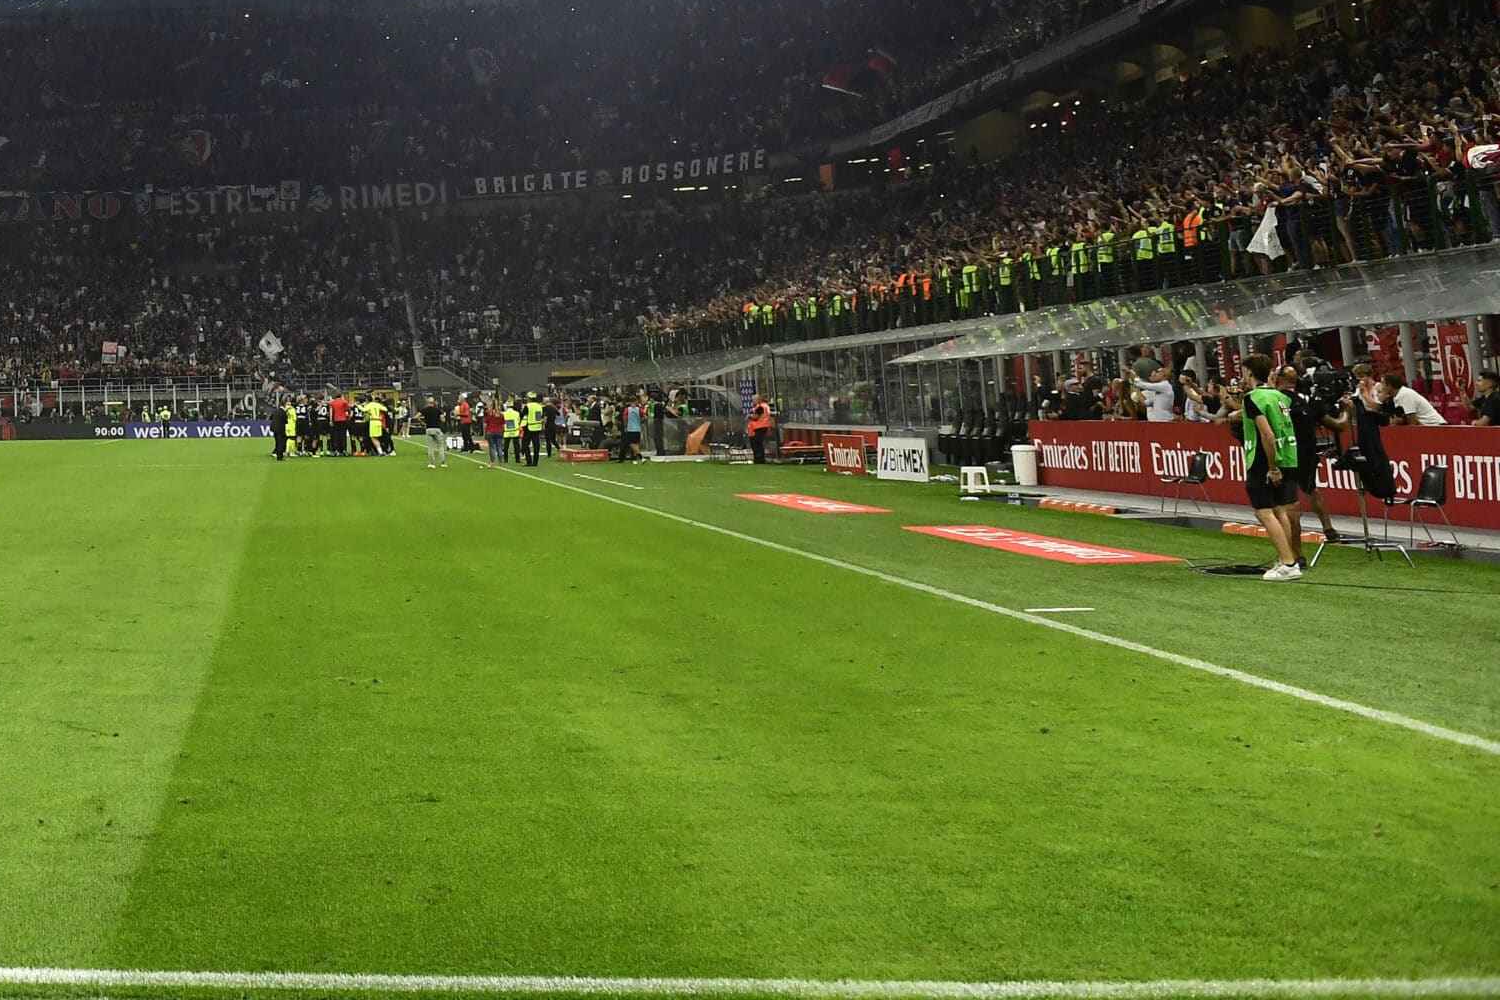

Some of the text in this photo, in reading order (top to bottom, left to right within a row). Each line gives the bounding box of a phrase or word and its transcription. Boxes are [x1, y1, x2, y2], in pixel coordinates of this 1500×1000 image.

[475, 149, 766, 195] BRIGATE ROSSONERE
[340, 179, 448, 210] RIMEDI
[94, 426, 125, 436] 90:00
[197, 422, 252, 438] wefox
[827, 442, 862, 469] Emirates
[889, 447, 926, 474] BitMEX
[1033, 438, 1142, 474] Emirates FLY BETTER
